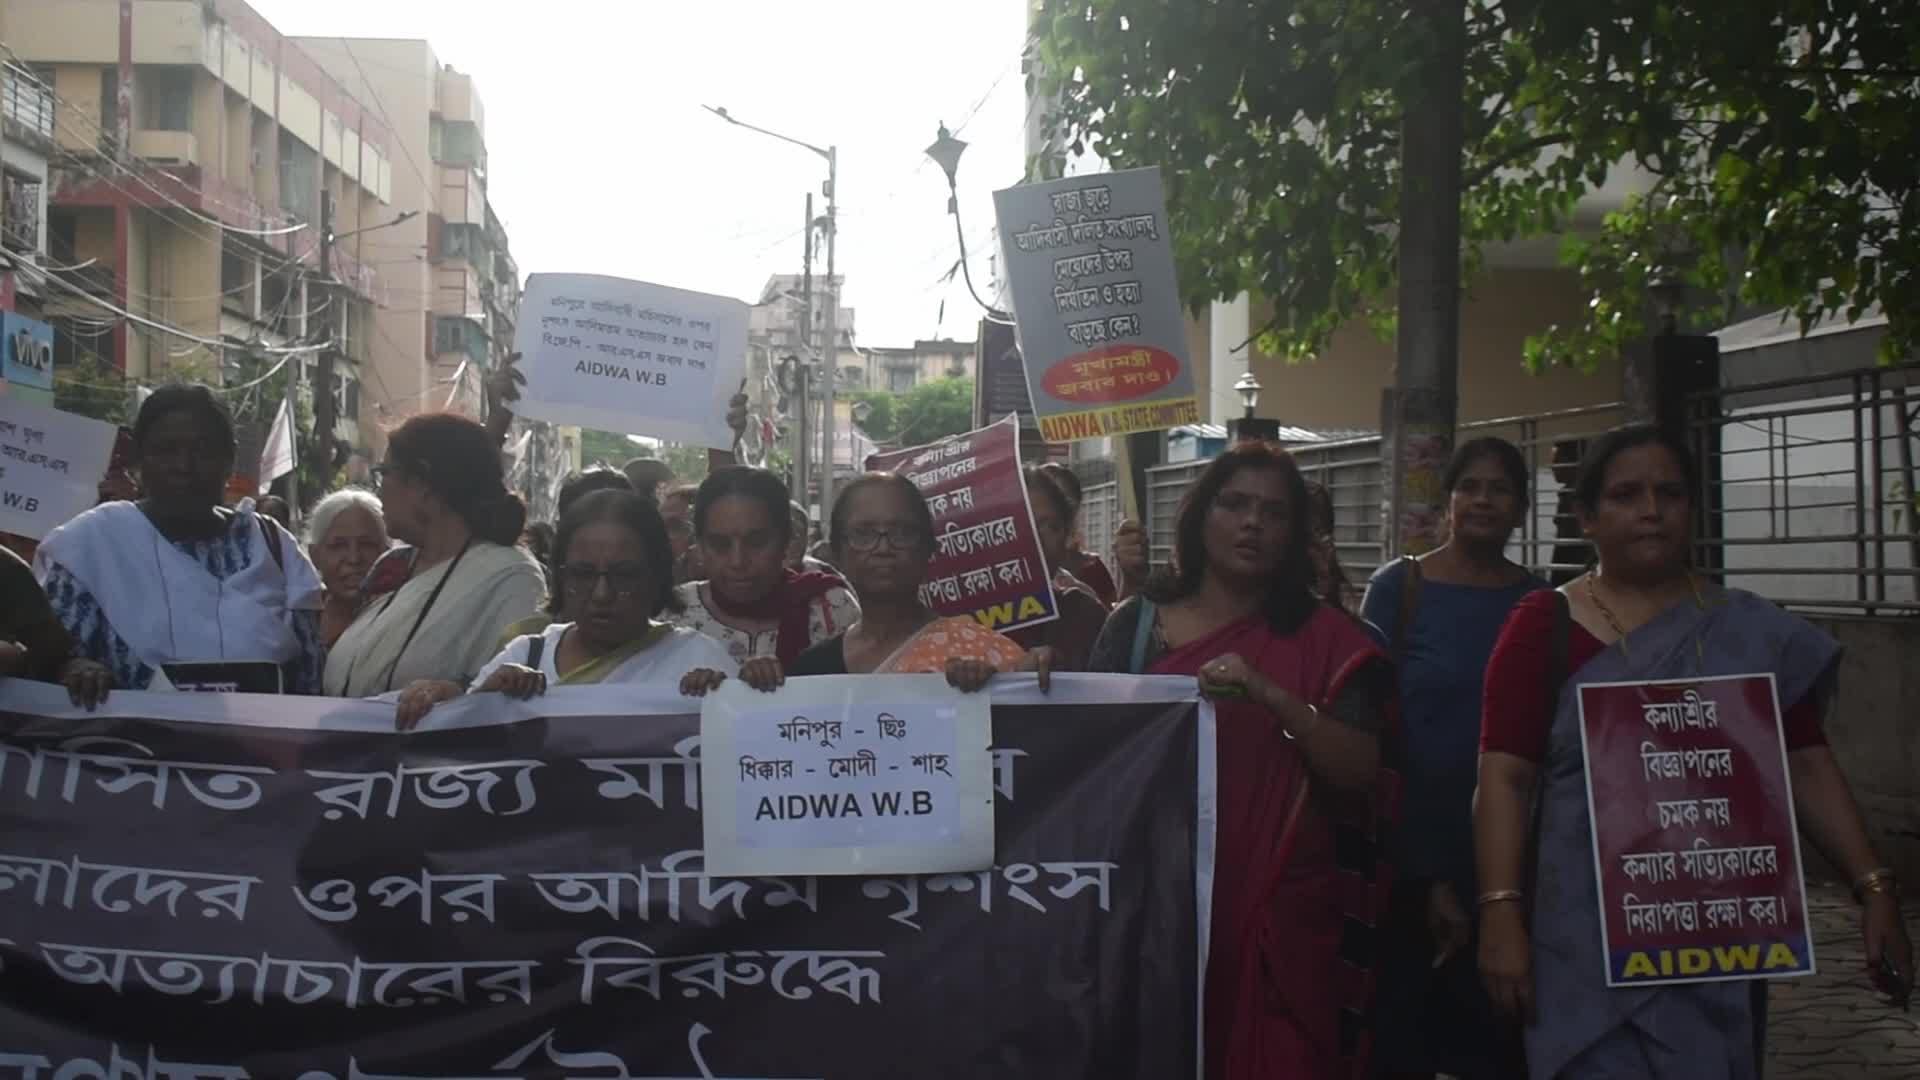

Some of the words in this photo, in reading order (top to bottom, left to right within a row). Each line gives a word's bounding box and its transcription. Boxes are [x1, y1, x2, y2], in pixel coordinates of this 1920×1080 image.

[574, 360, 630, 381] AIDWA
[636, 371, 667, 386] W.B
[1055, 374, 1118, 396] জবাব
[1041, 412, 1102, 441] AIDWA
[3, 490, 39, 512] W.B
[949, 486, 974, 511] নয়
[936, 516, 1017, 558] সত্যিকারের
[961, 567, 997, 596] রক্ষা
[1642, 689, 1719, 733] কন্যাশ্রীর
[777, 715, 843, 749] মনিপুর
[877, 712, 907, 740] ছিঃ
[738, 755, 794, 783] ধিক্কার
[828, 749, 878, 779] মোদী
[1640, 741, 1733, 782] বিজ্ঞাপনের
[305, 759, 548, 820] রাজ্য
[755, 793, 863, 822] AIDWA
[872, 790, 934, 818] W.B
[1657, 799, 1699, 830] চমক
[1701, 798, 1730, 826] নয়
[1621, 851, 1677, 885] কন্যার
[1682, 838, 1778, 880] সত্যিকারের
[293, 868, 508, 926] ওপর
[861, 860, 1119, 931] নৃশংস
[1623, 893, 1700, 935] নিরাপত্তা
[1703, 898, 1744, 929] রক্ষা
[39, 942, 541, 1008] অত্যাচারের
[568, 936, 886, 1005] বিরুদ্ধে
[1621, 943, 1799, 978] AIDWA
